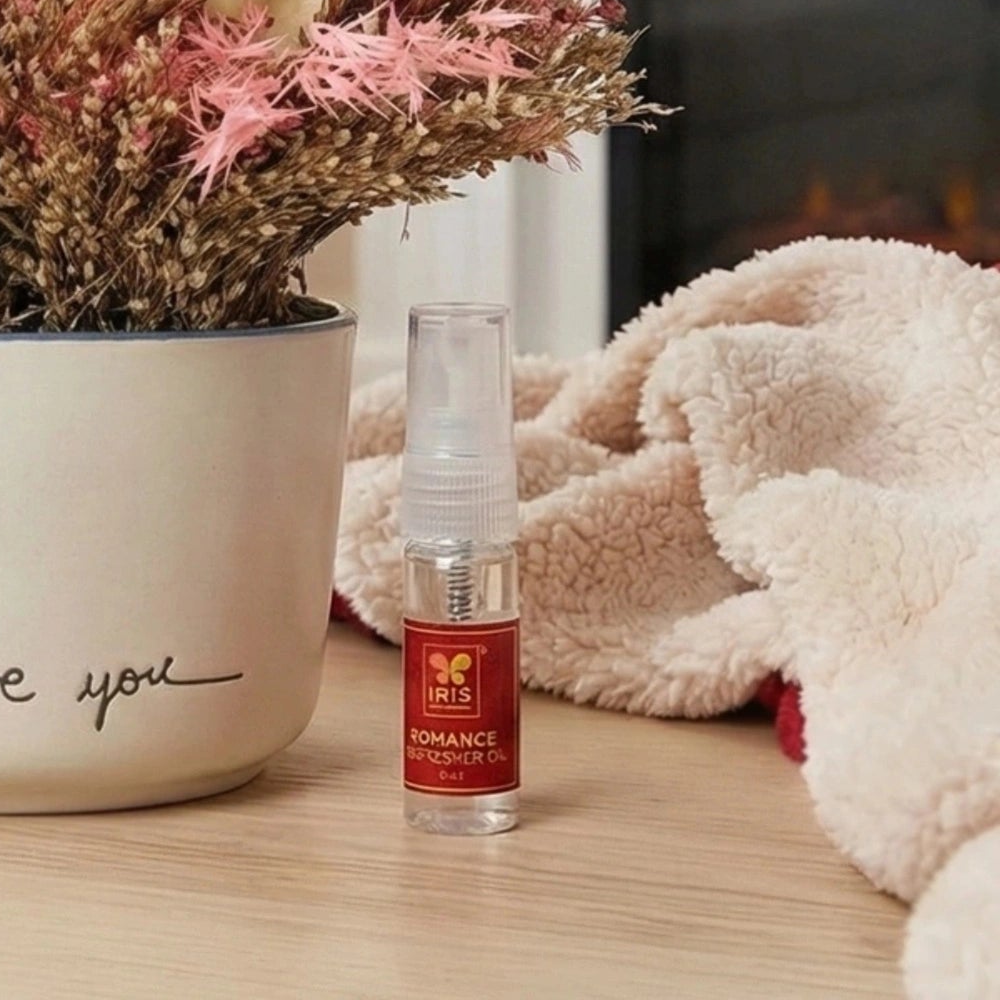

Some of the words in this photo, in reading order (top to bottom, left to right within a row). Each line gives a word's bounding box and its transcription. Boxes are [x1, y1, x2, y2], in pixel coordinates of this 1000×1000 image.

[76, 656, 244, 732] you
[428, 686, 473, 703] IRIS
[410, 728, 498, 748] ROMANCE
